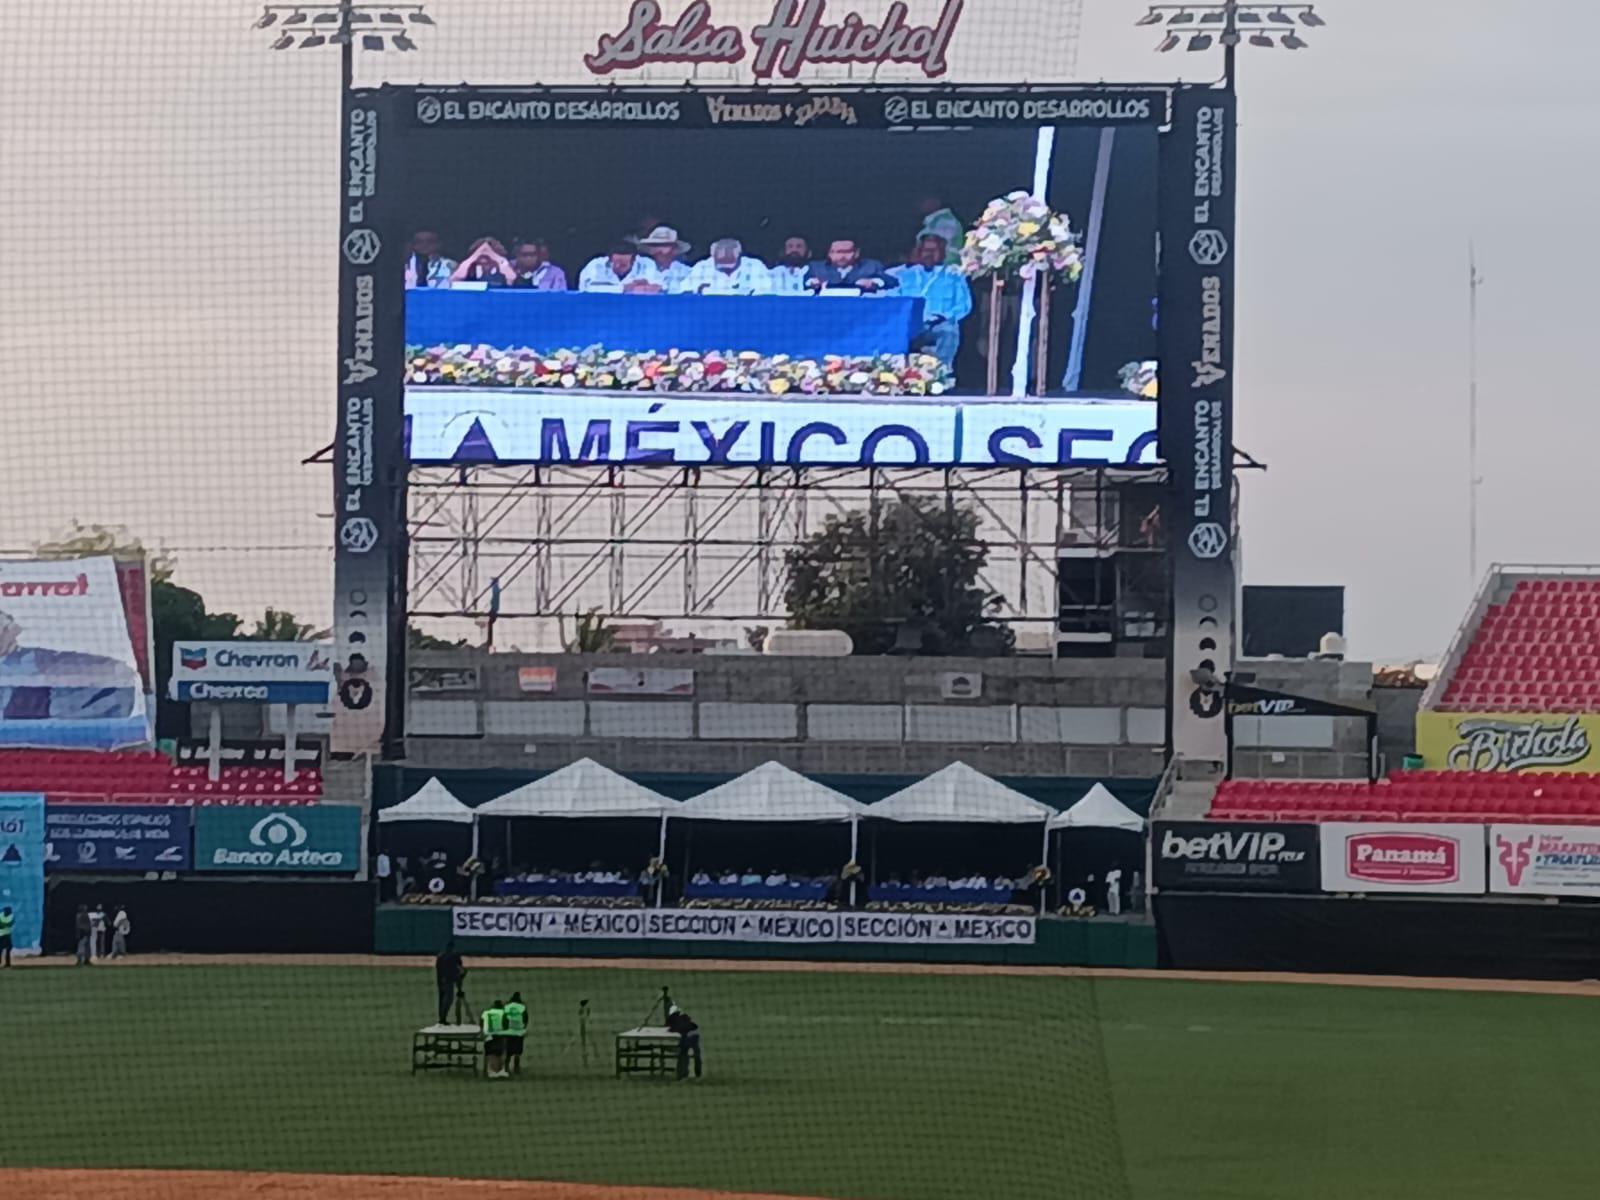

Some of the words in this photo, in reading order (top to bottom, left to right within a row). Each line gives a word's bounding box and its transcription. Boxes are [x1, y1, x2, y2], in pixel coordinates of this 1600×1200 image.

[586, 0, 746, 74] Salsa
[751, 0, 963, 77] Huichol
[443, 101, 465, 120] EL
[468, 101, 550, 120] ENCANTO
[554, 100, 680, 120] DESARROLLOS
[911, 100, 932, 119] EL
[936, 100, 1020, 119] ENCANTO
[1023, 100, 1150, 119] DESARROLLOS
[348, 108, 365, 197] ENCANTO
[1194, 106, 1212, 197] ENCANTO
[348, 201, 363, 223] EL
[1194, 200, 1210, 223] EL
[343, 274, 378, 385] VENADOS
[1191, 276, 1226, 388] VENADOS
[346, 397, 361, 486] ENCANTO
[1194, 400, 1210, 490] ENCANTO
[346, 487, 361, 511] EL
[1194, 494, 1210, 517] EL
[215, 650, 299, 668] Chevron
[213, 848, 273, 865] Banco
[275, 848, 343, 866] Azteca
[1356, 844, 1447, 865] Panamá
